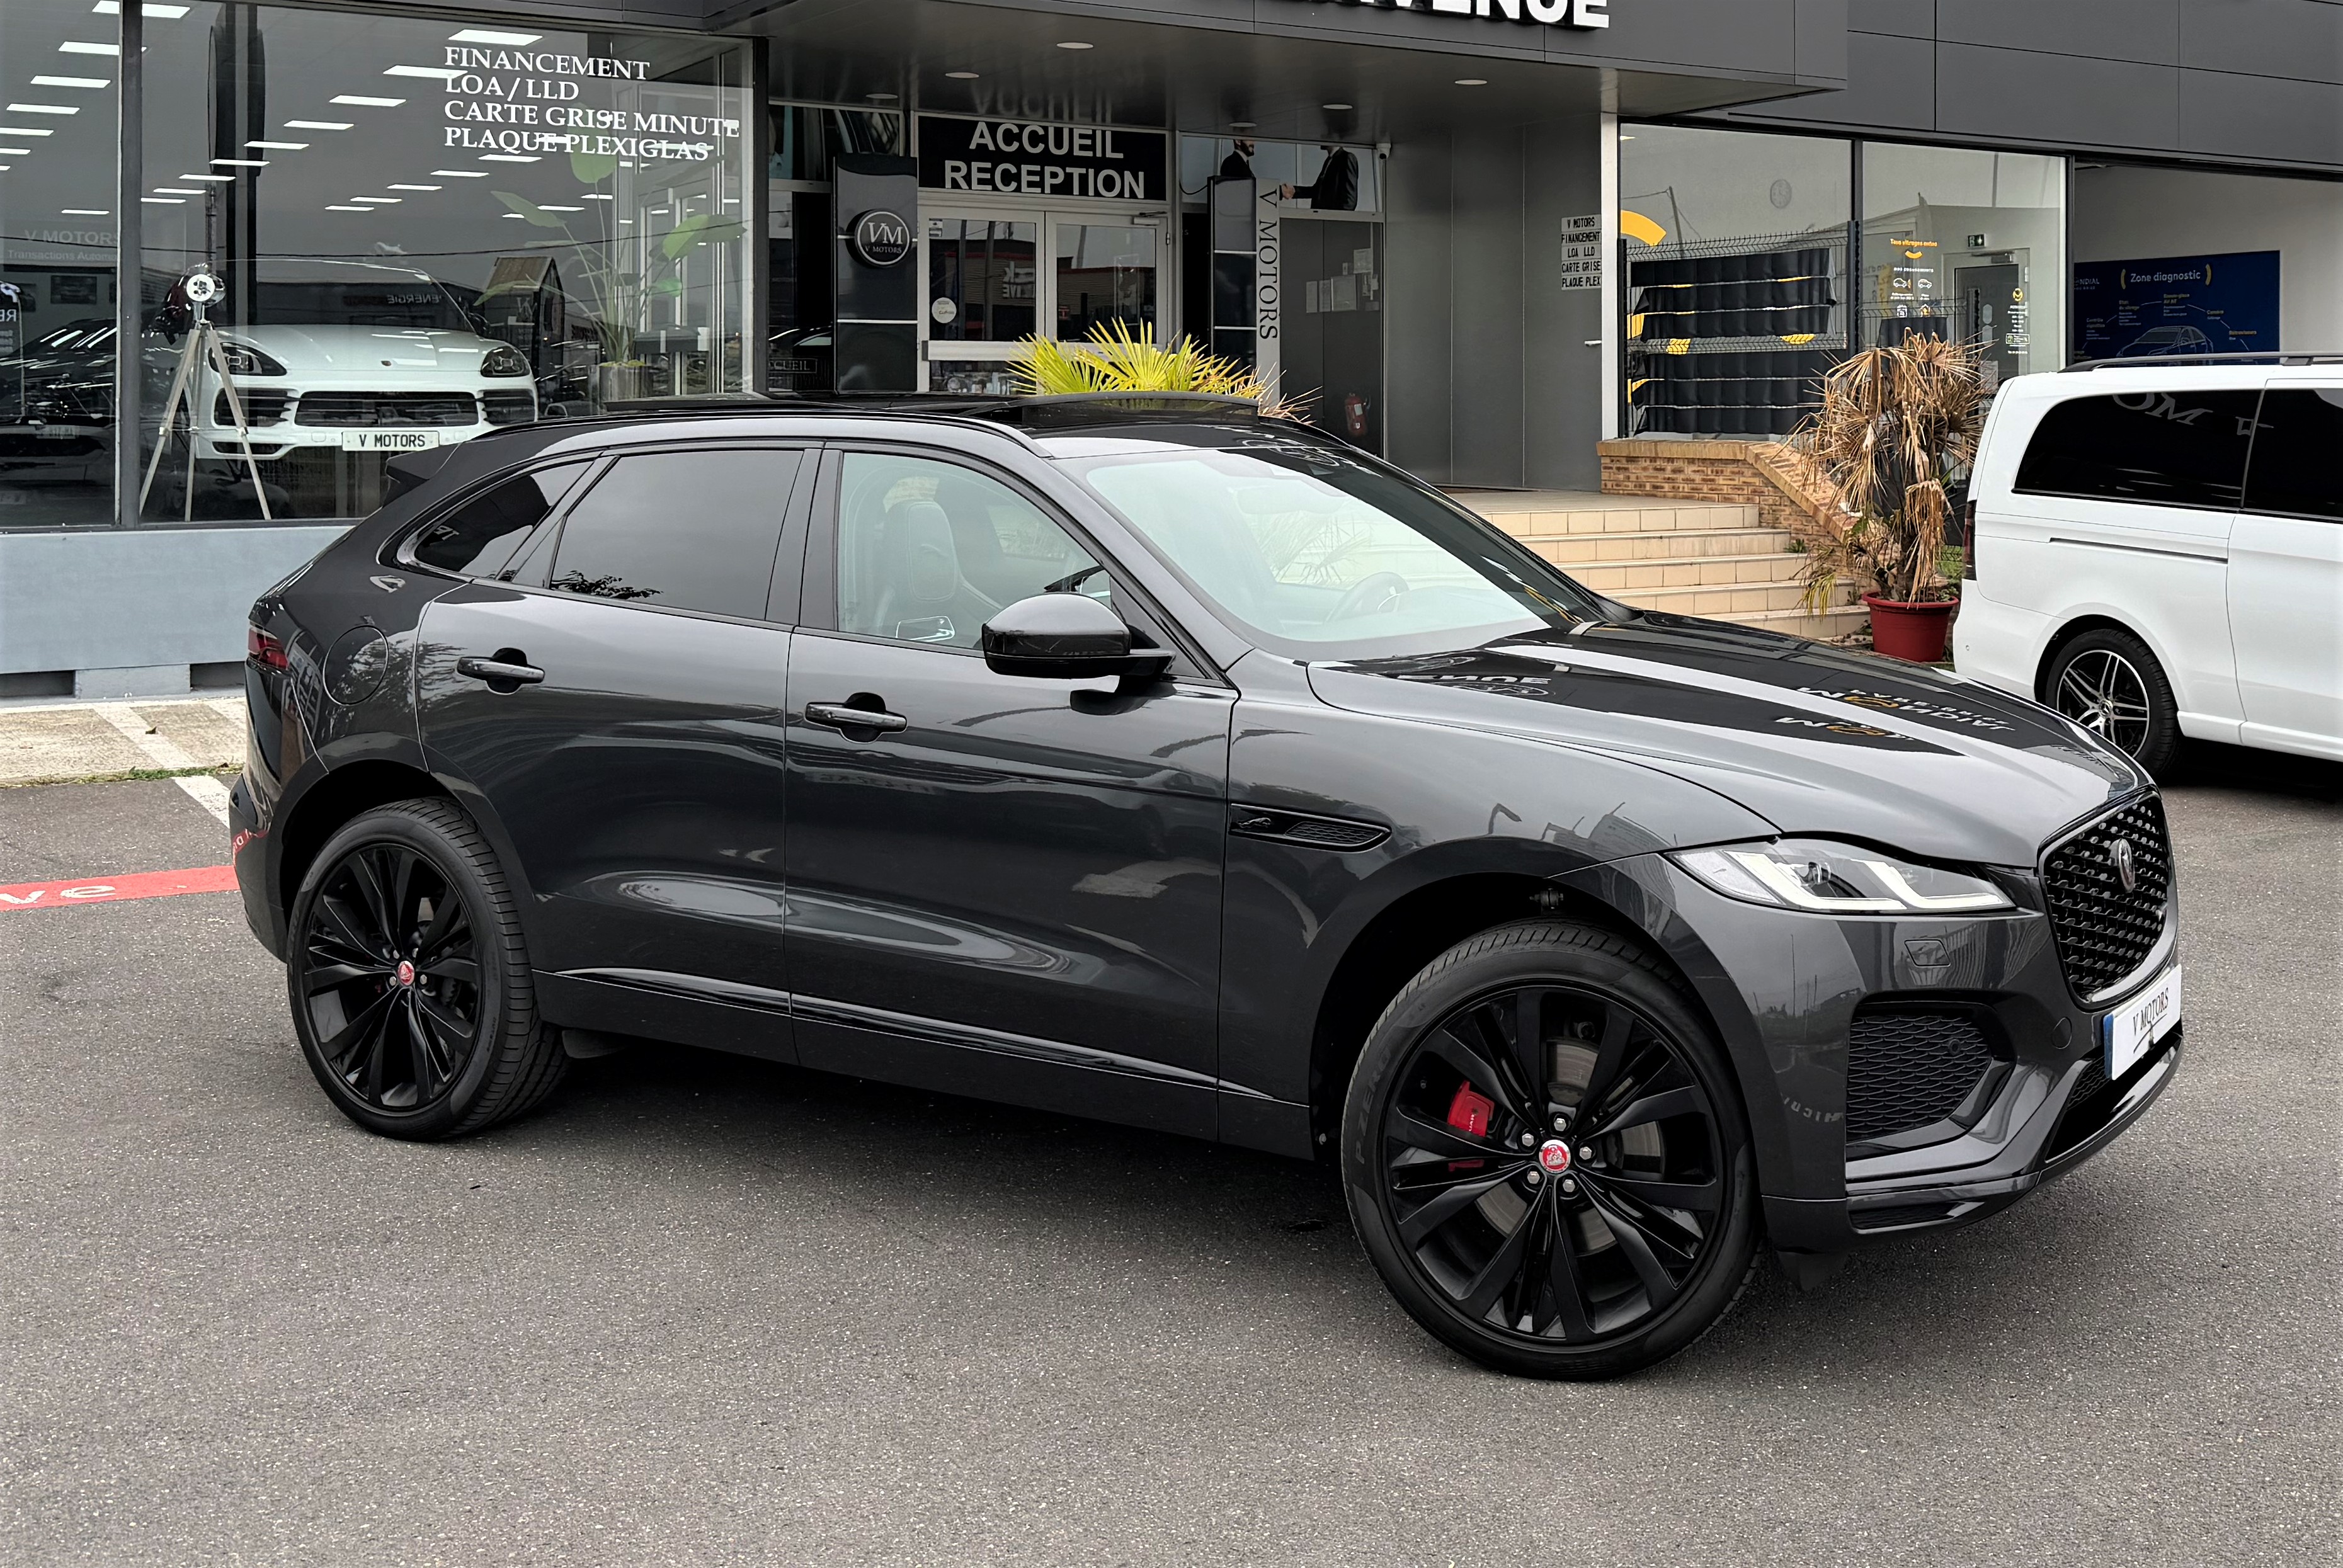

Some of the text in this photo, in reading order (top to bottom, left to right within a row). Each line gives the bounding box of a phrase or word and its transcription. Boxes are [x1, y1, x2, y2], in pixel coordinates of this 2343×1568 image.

[445, 47, 650, 80] FINANCEMENT
[444, 101, 740, 137] CARTE GRISE MINUTE
[444, 127, 709, 161] PLAQUE PLEXIGLAS
[969, 121, 1124, 159] ACCUEIL
[945, 160, 1144, 199] RECEPTION
[1567, 217, 1595, 229] V MOTORS
[868, 222, 904, 244] VM
[1561, 231, 1600, 244] FINANCEMENT
[8, 250, 76, 261] Transactions
[1568, 246, 1595, 258] LOA LLD
[1259, 189, 1278, 339] V MOTORS
[1562, 261, 1600, 273] CARTE GRISE
[1562, 276, 1600, 288] PLAQUE PLEX
[2130, 270, 2201, 283] Zone diagnostic
[769, 360, 810, 371] CCUEIL
[359, 435, 425, 448] V MOTORS
[2133, 987, 2169, 1036] V MOTORS
